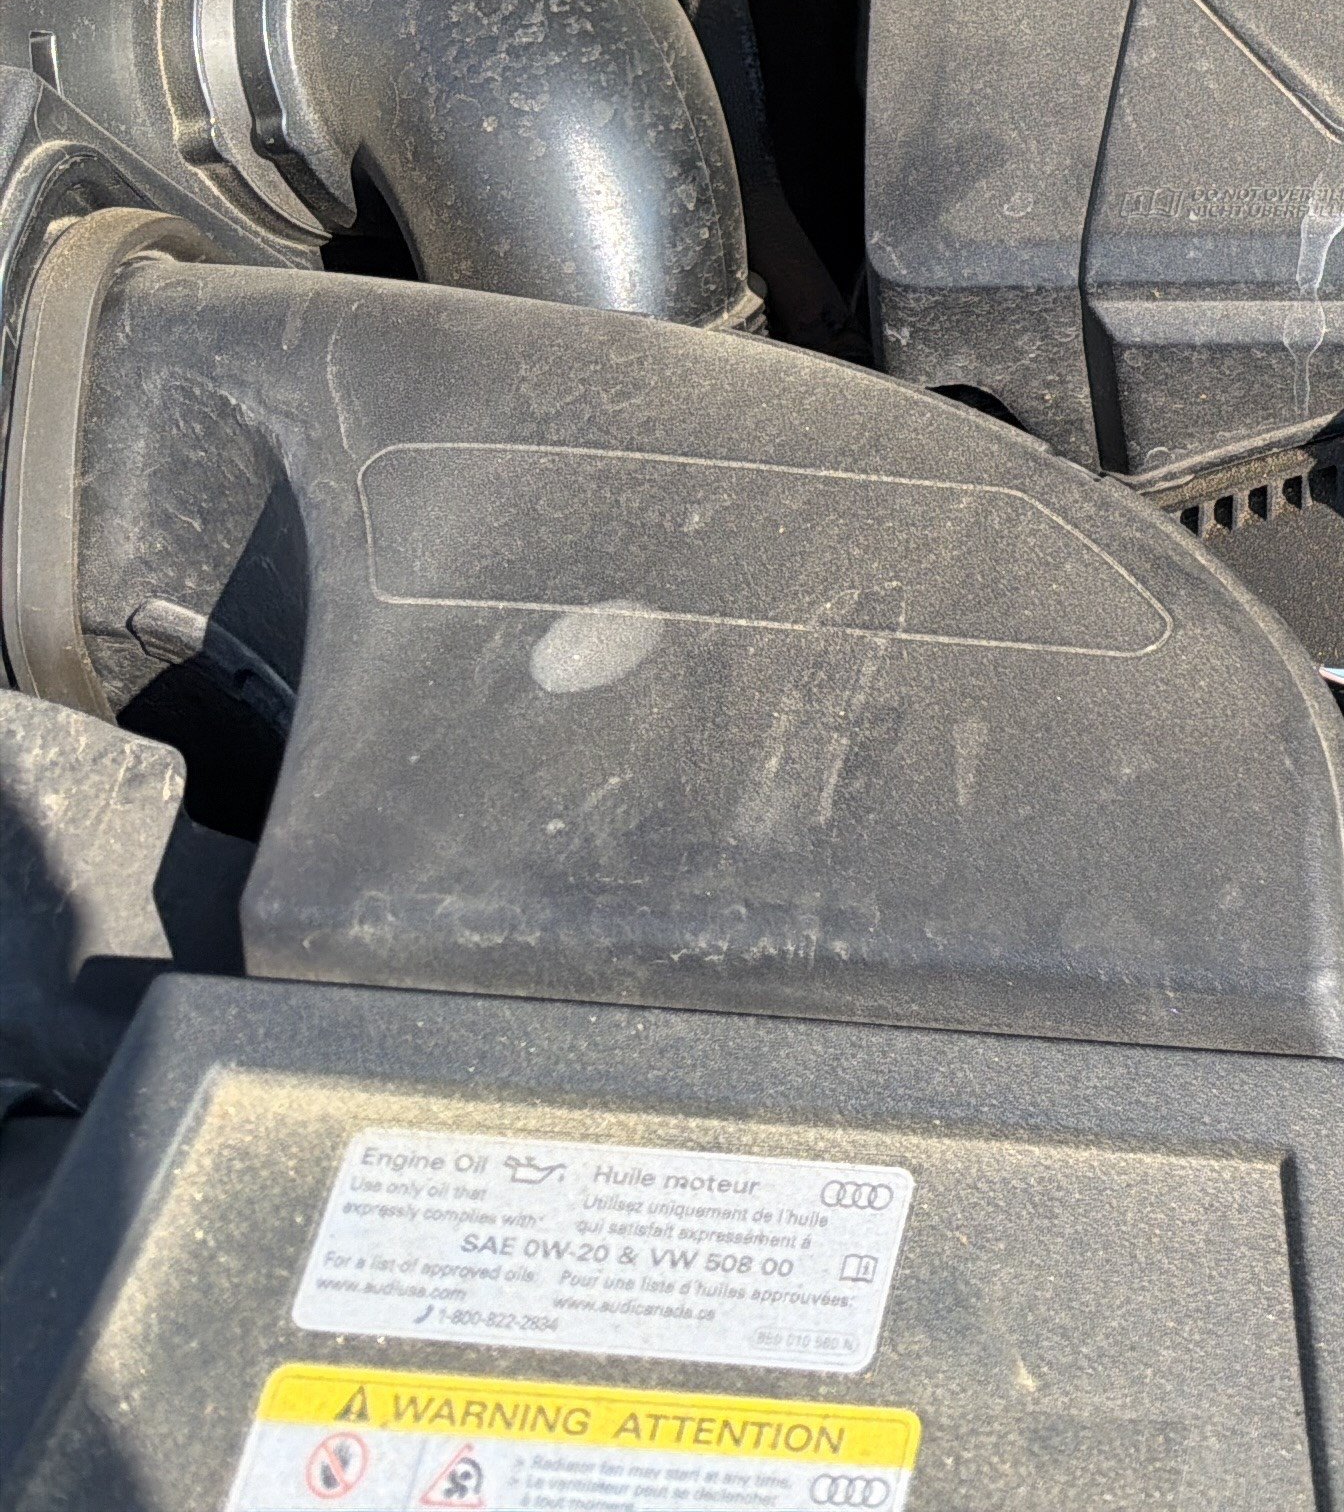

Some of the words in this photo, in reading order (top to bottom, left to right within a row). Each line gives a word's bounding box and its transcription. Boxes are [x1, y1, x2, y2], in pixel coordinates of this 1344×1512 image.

[1221, 189, 1260, 202] NOT
[361, 1146, 446, 1172] Engine
[454, 1153, 488, 1174] Oil
[593, 1165, 656, 1187] Huile
[663, 1173, 760, 1196] moteur
[351, 1176, 383, 1193] Use
[386, 1178, 421, 1199] only
[427, 1180, 449, 1197] oil
[453, 1182, 488, 1201] that
[342, 1201, 419, 1222] expressly
[423, 1205, 497, 1229] complies
[582, 1194, 644, 1215] Utilisez
[648, 1199, 748, 1224] uniquement
[751, 1206, 773, 1223] de
[576, 1218, 603, 1237] qui
[608, 1221, 674, 1241] satisfait
[678, 1224, 793, 1248] expressément
[323, 1250, 350, 1270] For
[355, 1256, 366, 1270] a
[370, 1254, 396, 1272] list
[400, 1257, 419, 1274] of
[421, 1259, 501, 1281] approved
[460, 1233, 517, 1257] SAE
[523, 1237, 610, 1264] 0W-20
[616, 1244, 638, 1265] &
[652, 1247, 699, 1270] VW
[704, 1253, 753, 1274] 508
[760, 1257, 794, 1278] 00
[561, 1270, 598, 1288] Pour
[603, 1274, 636, 1290] une
[641, 1276, 673, 1295] liste
[393, 1391, 593, 1436] WARNING
[612, 1412, 846, 1455] ATTENTION
[524, 1475, 545, 1490] Le
[529, 1454, 596, 1476] Radiator
[599, 1459, 626, 1477] fan
[629, 1464, 660, 1484] may
[664, 1465, 699, 1483] start
[703, 1470, 720, 1485] at
[724, 1472, 752, 1491] any
